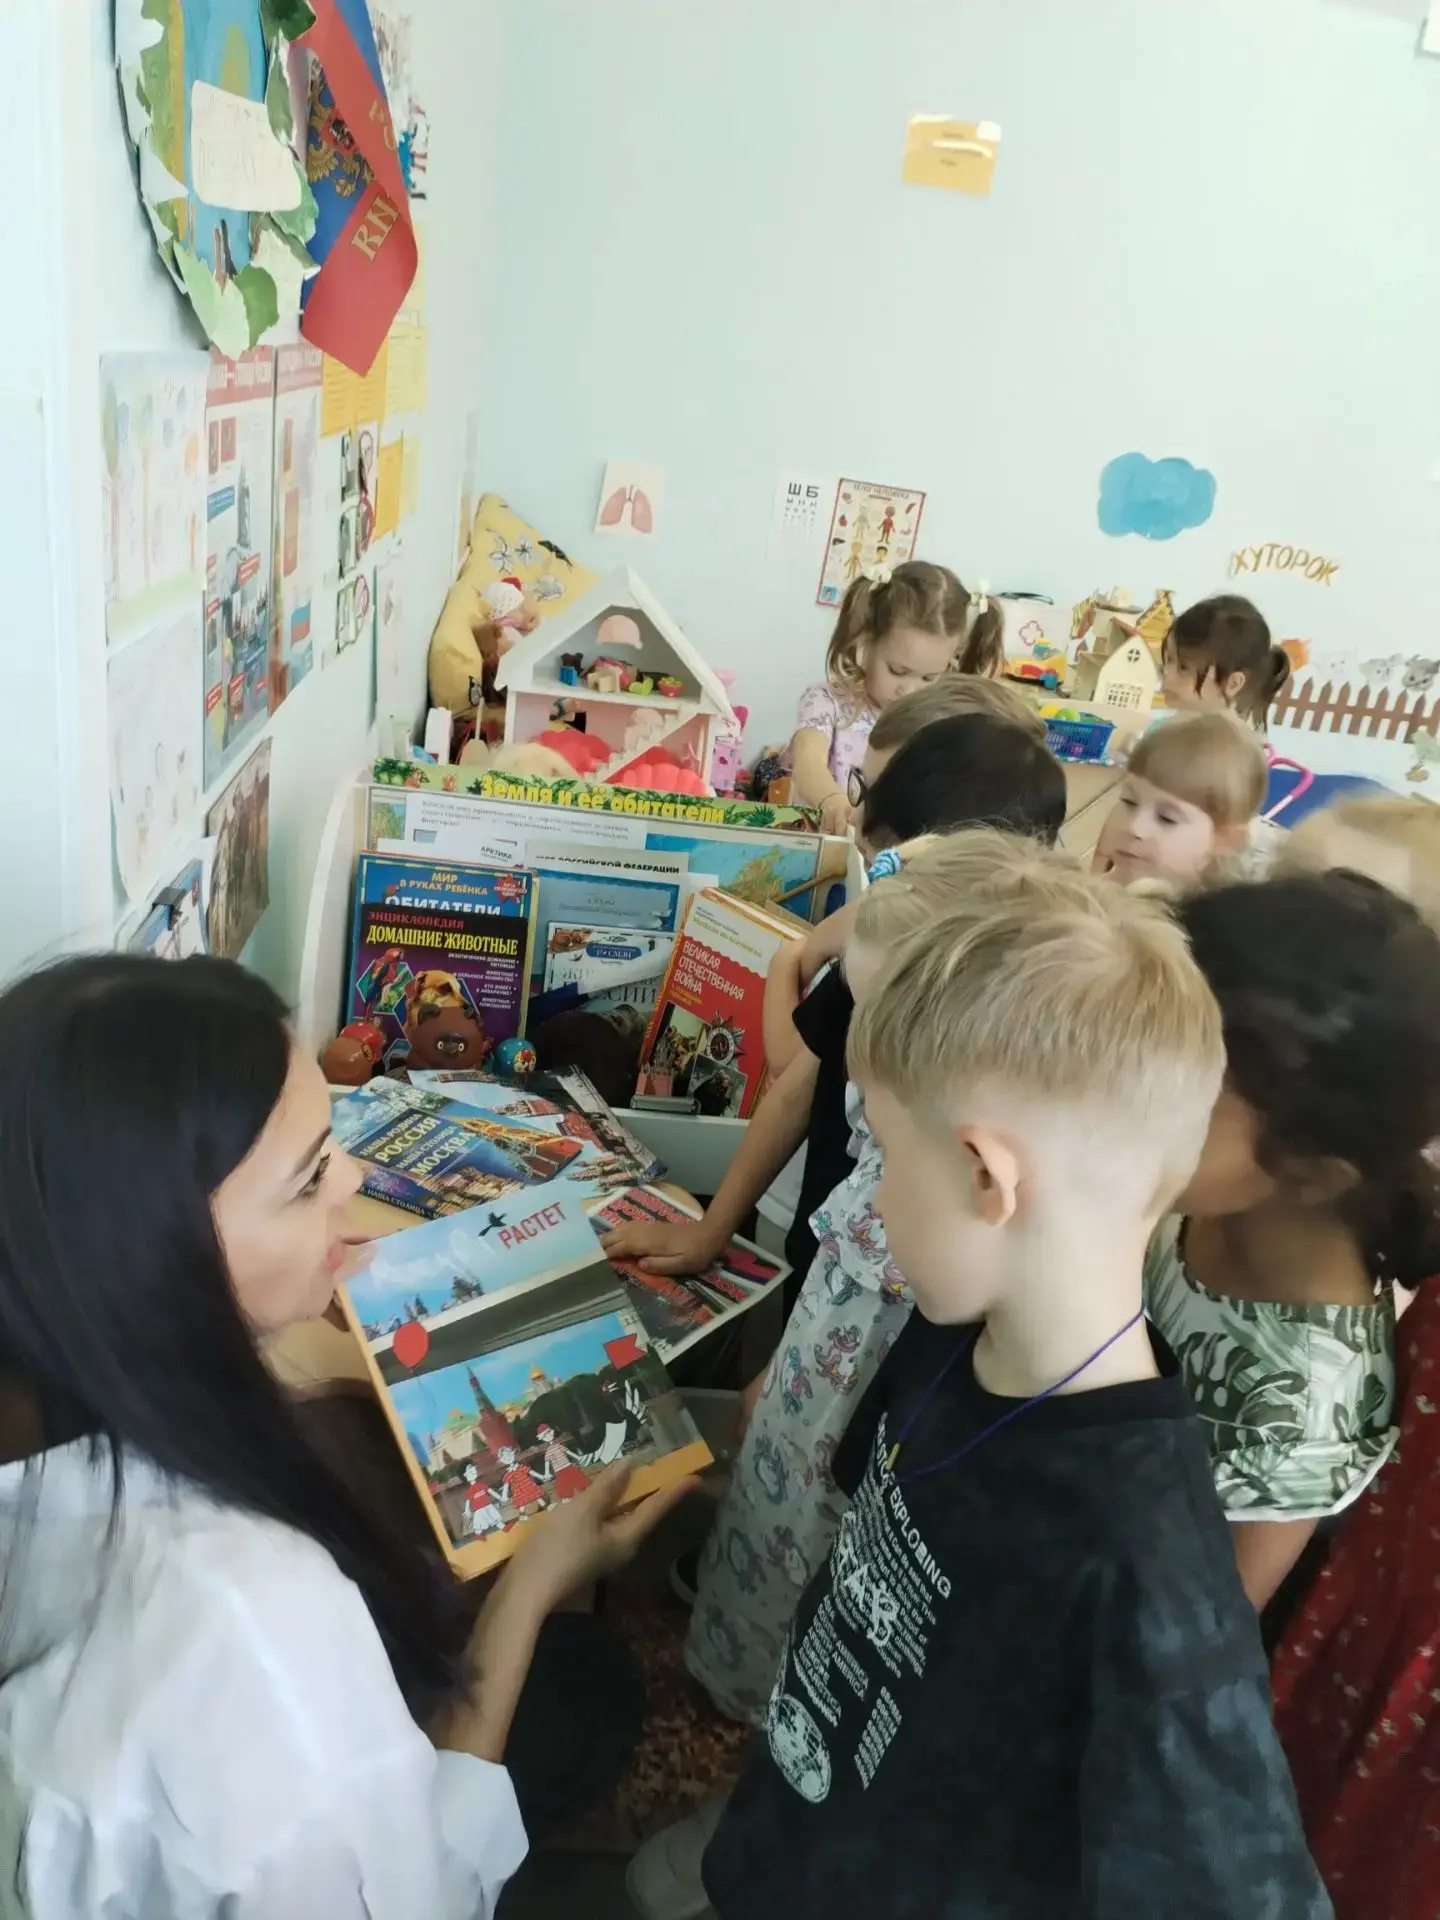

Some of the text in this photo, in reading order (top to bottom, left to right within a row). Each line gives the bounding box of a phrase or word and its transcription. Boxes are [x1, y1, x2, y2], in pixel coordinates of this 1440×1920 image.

[788, 482, 820, 498] Ш Б
[1233, 542, 1339, 587] ХУТОРОК
[481, 774, 553, 802] Земля
[558, 789, 573, 806] и
[577, 786, 605, 810] её
[610, 792, 725, 823] обитатели
[480, 846, 513, 859] АРКТИКА
[400, 879, 407, 888] В
[409, 881, 442, 892] РУКАХ
[445, 884, 489, 896] РЕБЁНКА
[431, 872, 458, 884] МИР
[368, 911, 464, 929] ЭНЦИКЛОПЕДИЯ
[366, 925, 519, 956] ДОМАШНИЕ ЖИВОТНЫЕ
[682, 940, 721, 970] ВЕЛИКАЯ
[673, 969, 703, 995] ВОЙНА
[678, 955, 746, 1001] ОТЕЧЕСТВЕННАЯ
[374, 1116, 442, 1164] РОССИЯ
[409, 1131, 477, 1176] МОСКВА
[497, 1201, 567, 1250] РАСТЕТ
[832, 1650, 865, 1701] AMERICA
